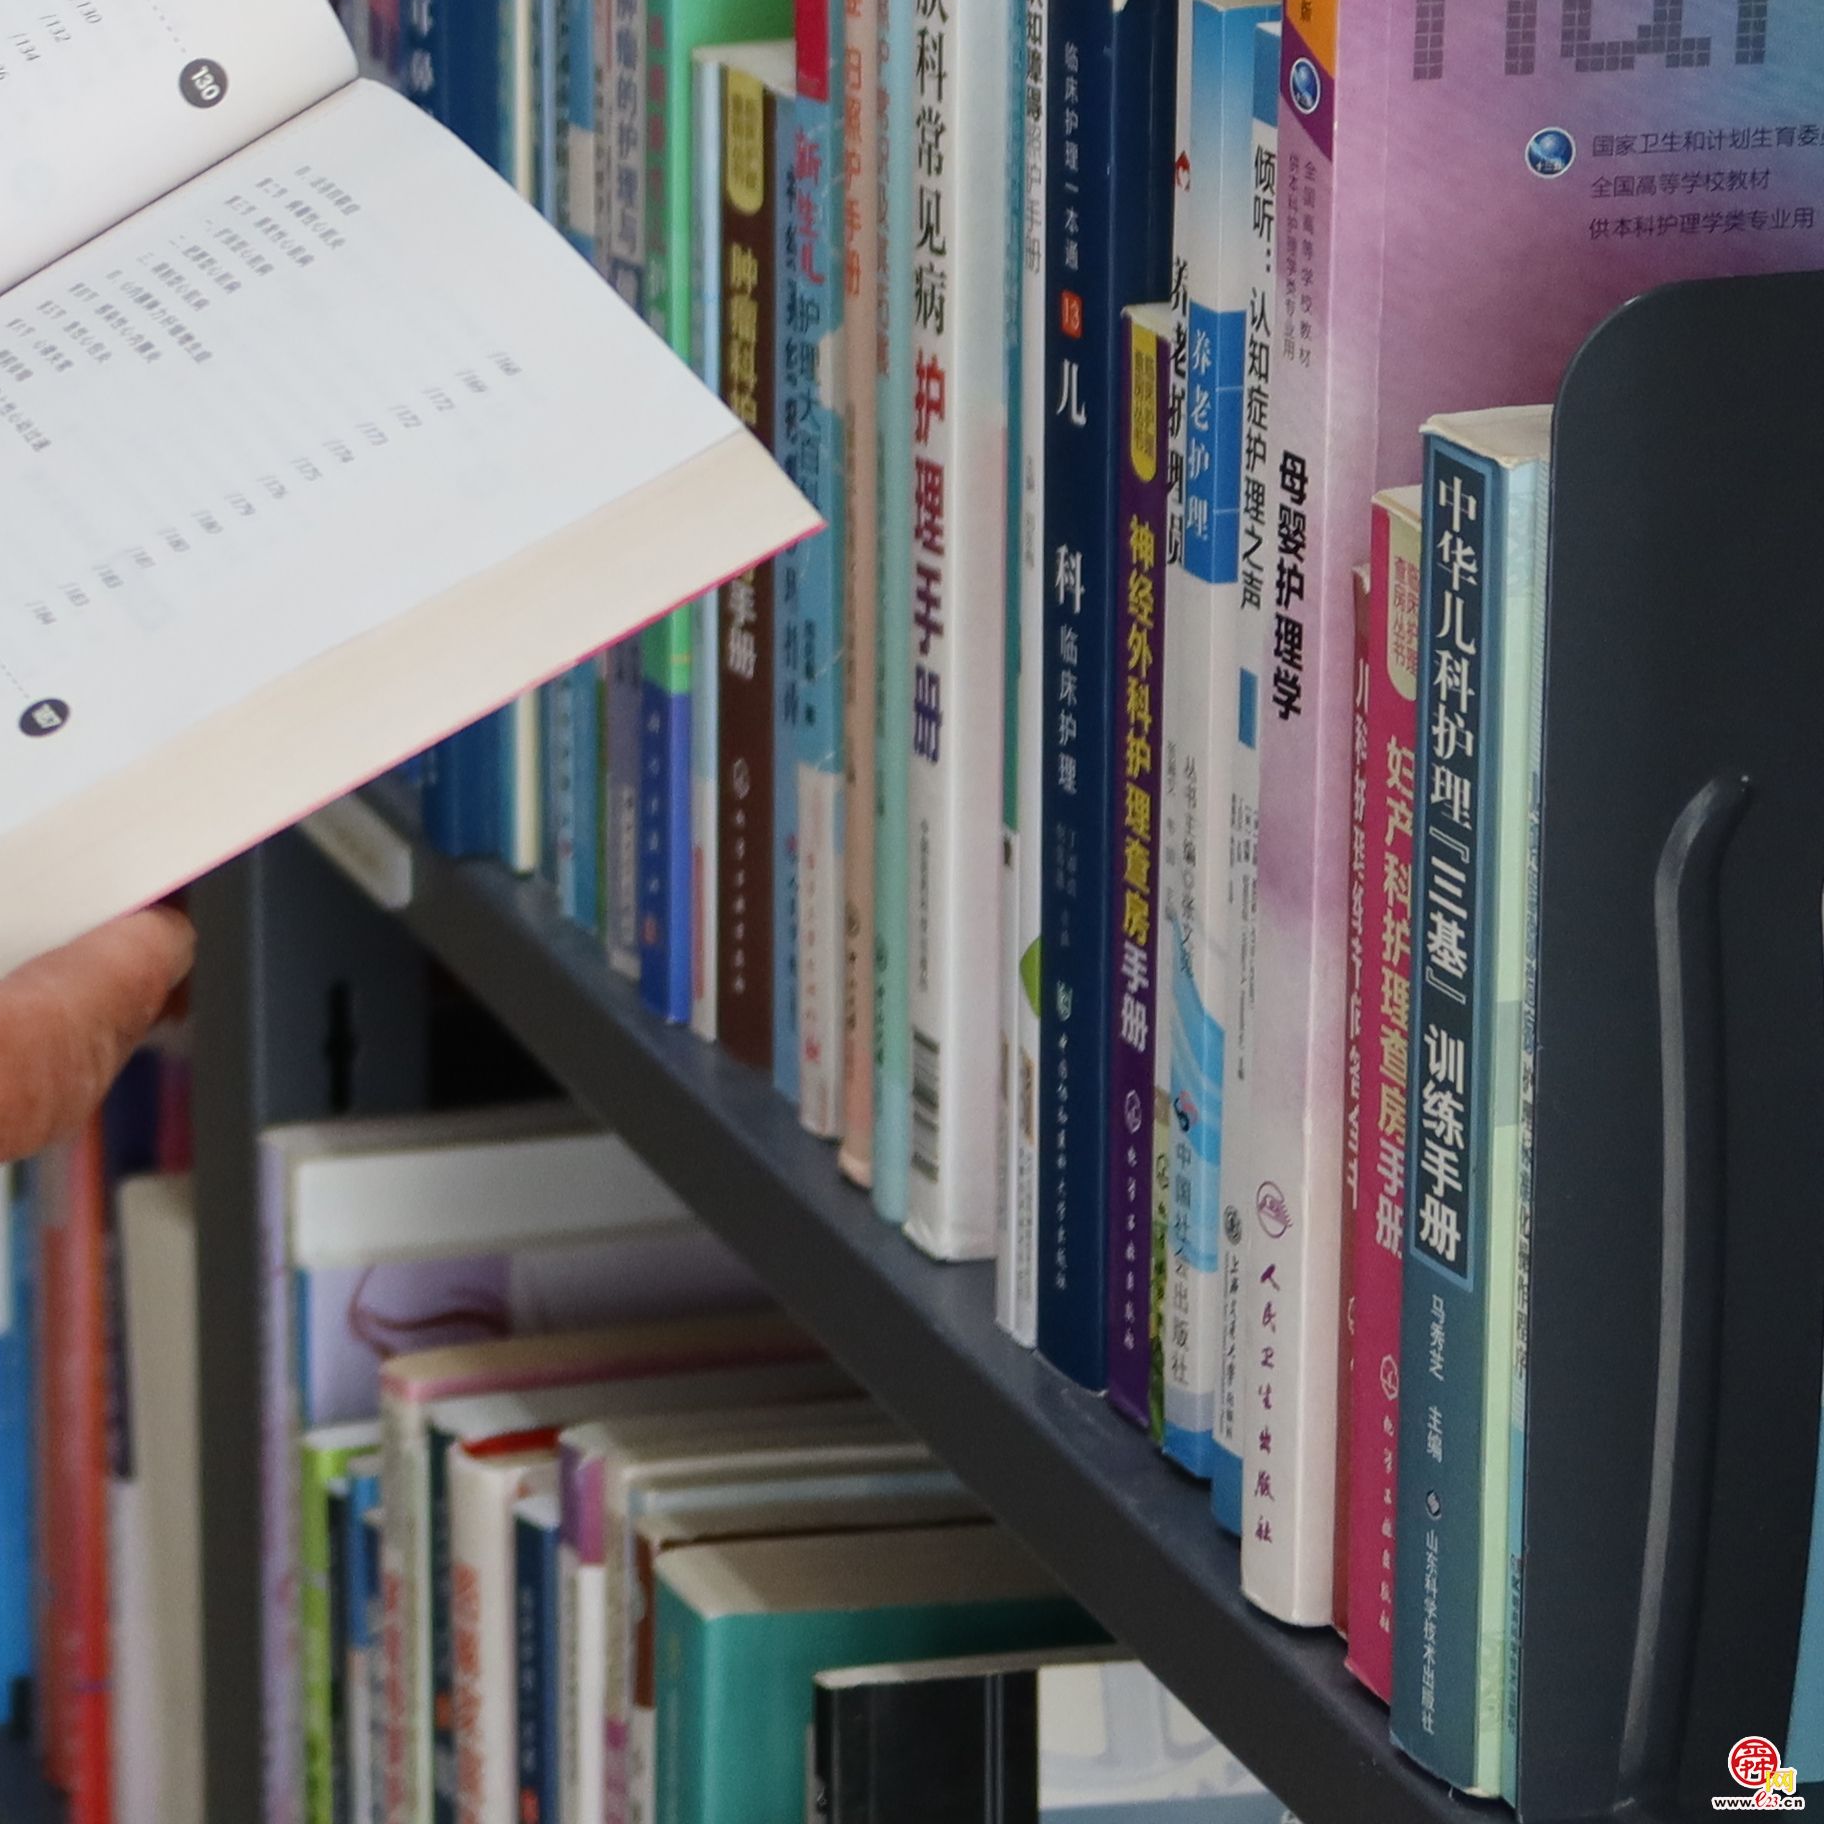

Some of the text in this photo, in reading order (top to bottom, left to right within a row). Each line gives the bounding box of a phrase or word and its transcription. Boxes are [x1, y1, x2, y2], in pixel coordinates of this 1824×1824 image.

[12, 33, 41, 62] /134
[39, 14, 72, 43] /132
[183, 62, 225, 104] 130
[1063, 41, 1081, 330] 临床护理一本通 13
[1298, 161, 1316, 367] 全国高等学校教材
[1587, 206, 1816, 241] 供本科护理学类专业用
[1590, 166, 1772, 200] 全国高等学校教材
[1185, 328, 1213, 542] 养老护理
[1272, 450, 1309, 721] 母婴护理学
[1057, 623, 1079, 796] 临床护理
[1119, 513, 1156, 1054] 神经外科护理查房手册
[1375, 733, 1417, 1260] 妇产科护理查房手册
[1170, 1142, 1193, 1386] 中国社会出版社
[1254, 1262, 1281, 1544] 人民卫生出版社
[1425, 1405, 1444, 1465] 主编
[1420, 1529, 1440, 1737] 山东科学技术出版社
